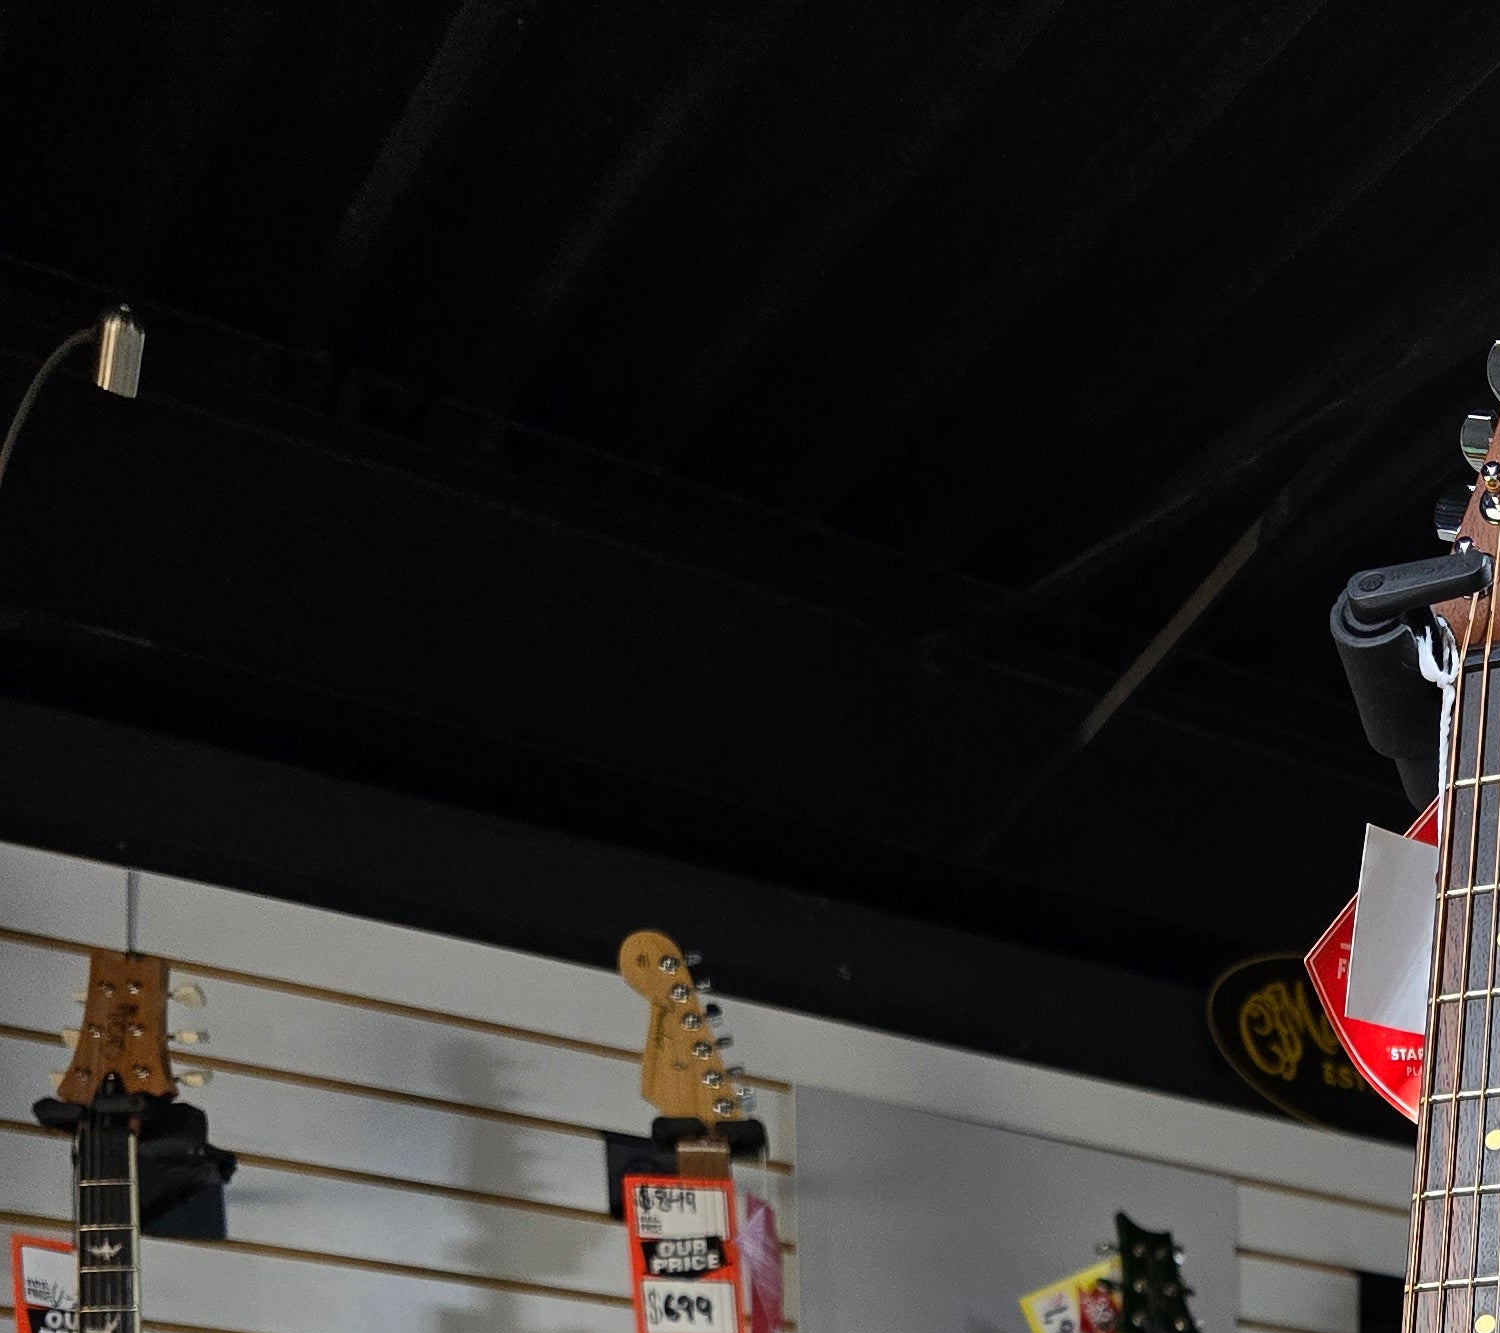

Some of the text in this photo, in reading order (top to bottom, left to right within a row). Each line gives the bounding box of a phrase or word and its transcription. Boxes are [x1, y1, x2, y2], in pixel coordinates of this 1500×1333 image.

[659, 1238, 708, 1258] OUR
[652, 1254, 720, 1275] PRICE
[44, 1308, 79, 1330] OU
